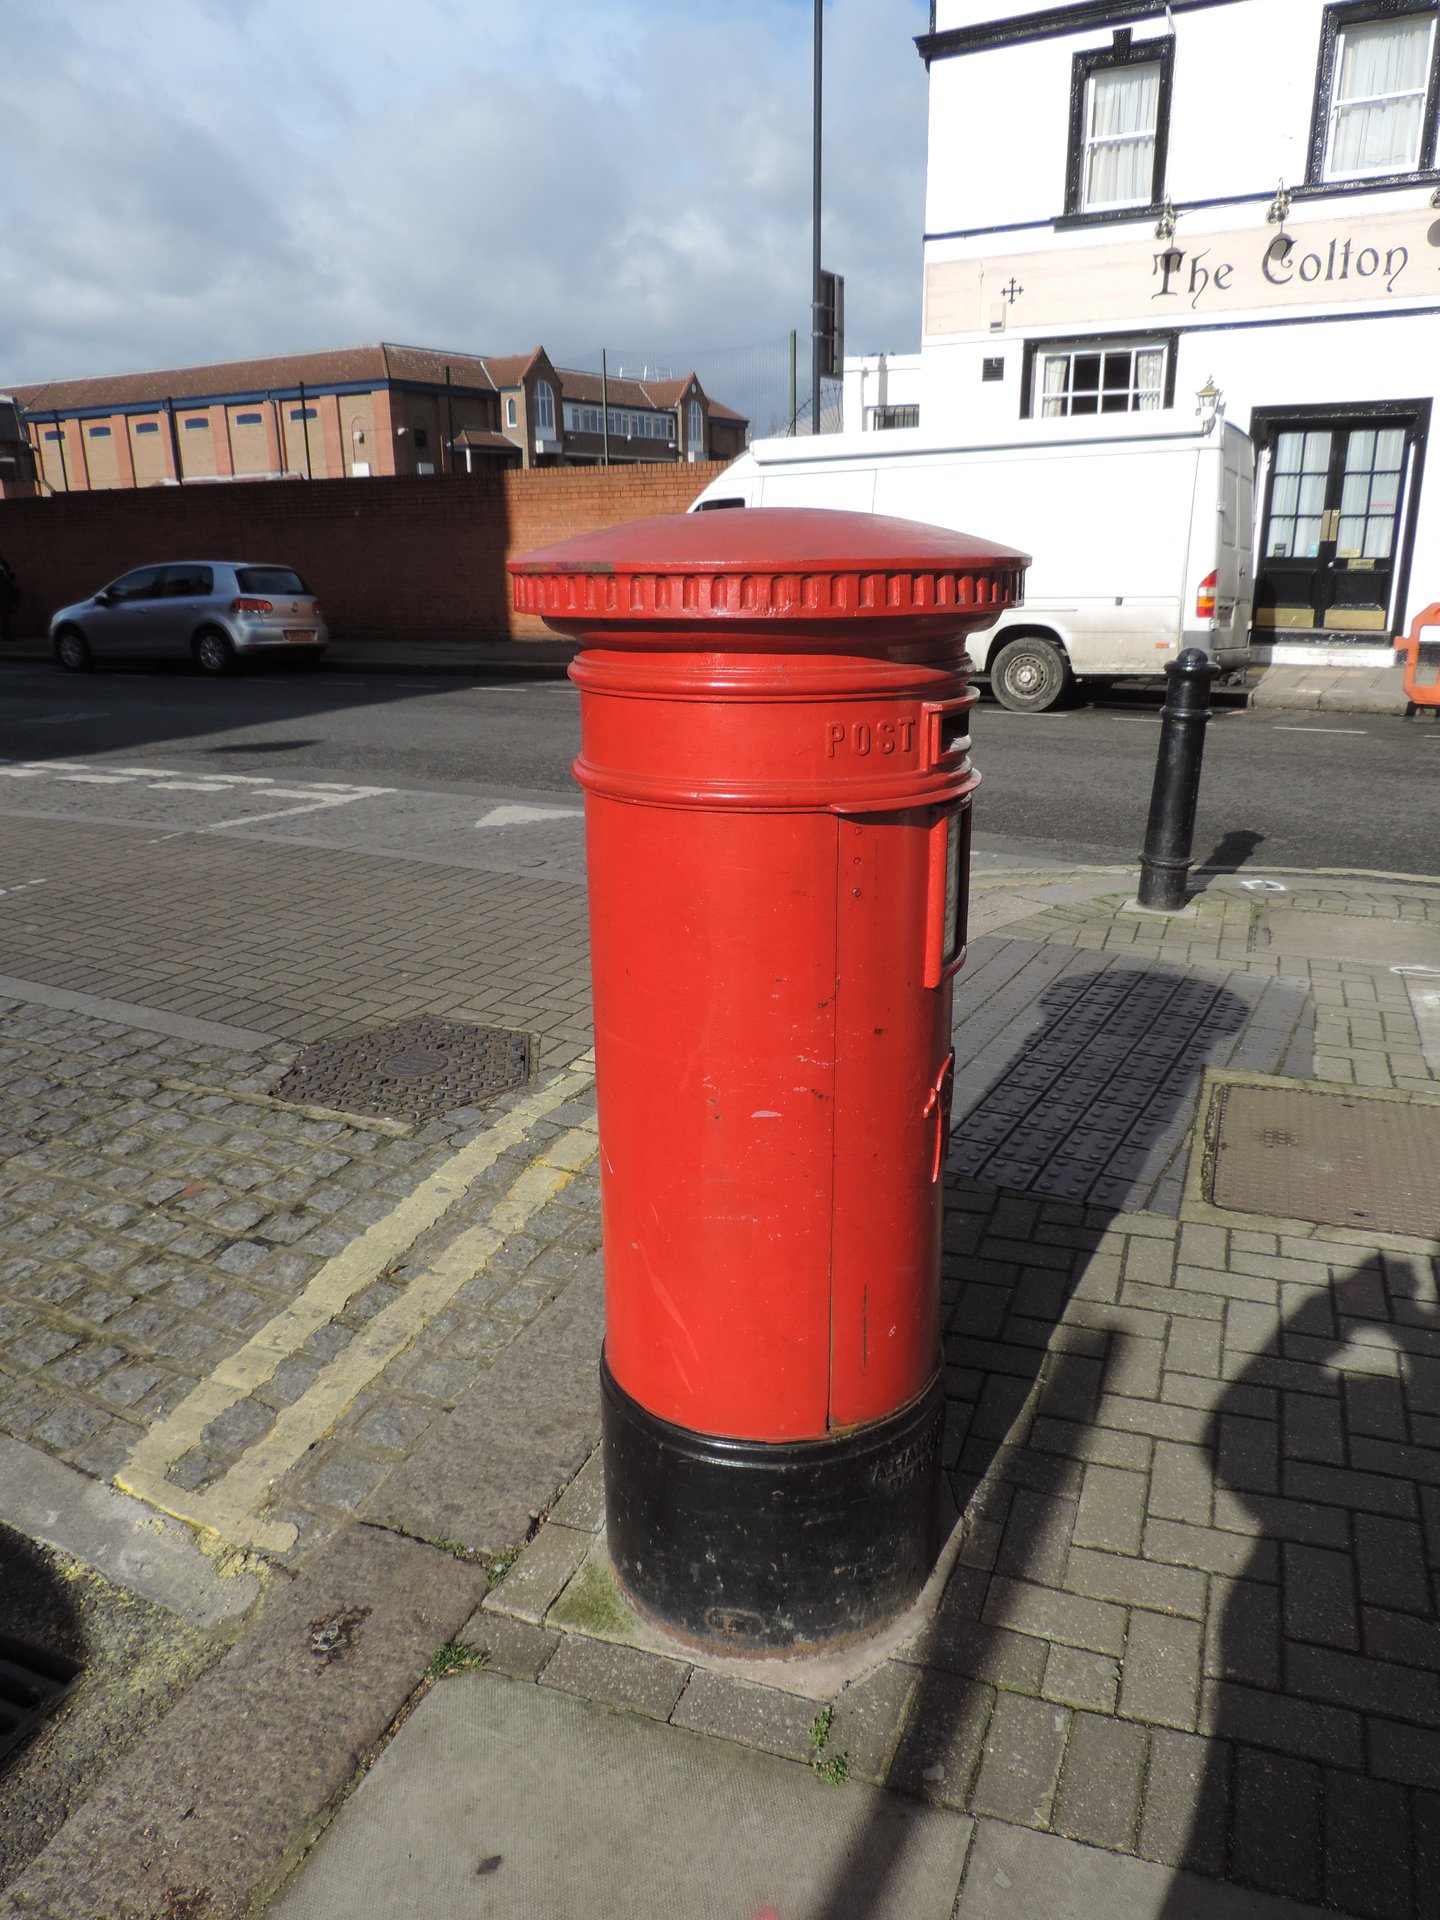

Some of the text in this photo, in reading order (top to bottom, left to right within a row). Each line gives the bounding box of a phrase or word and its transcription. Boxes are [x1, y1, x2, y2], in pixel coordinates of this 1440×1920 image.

[1151, 237, 1408, 309] The Colton
[825, 716, 916, 758] POST
